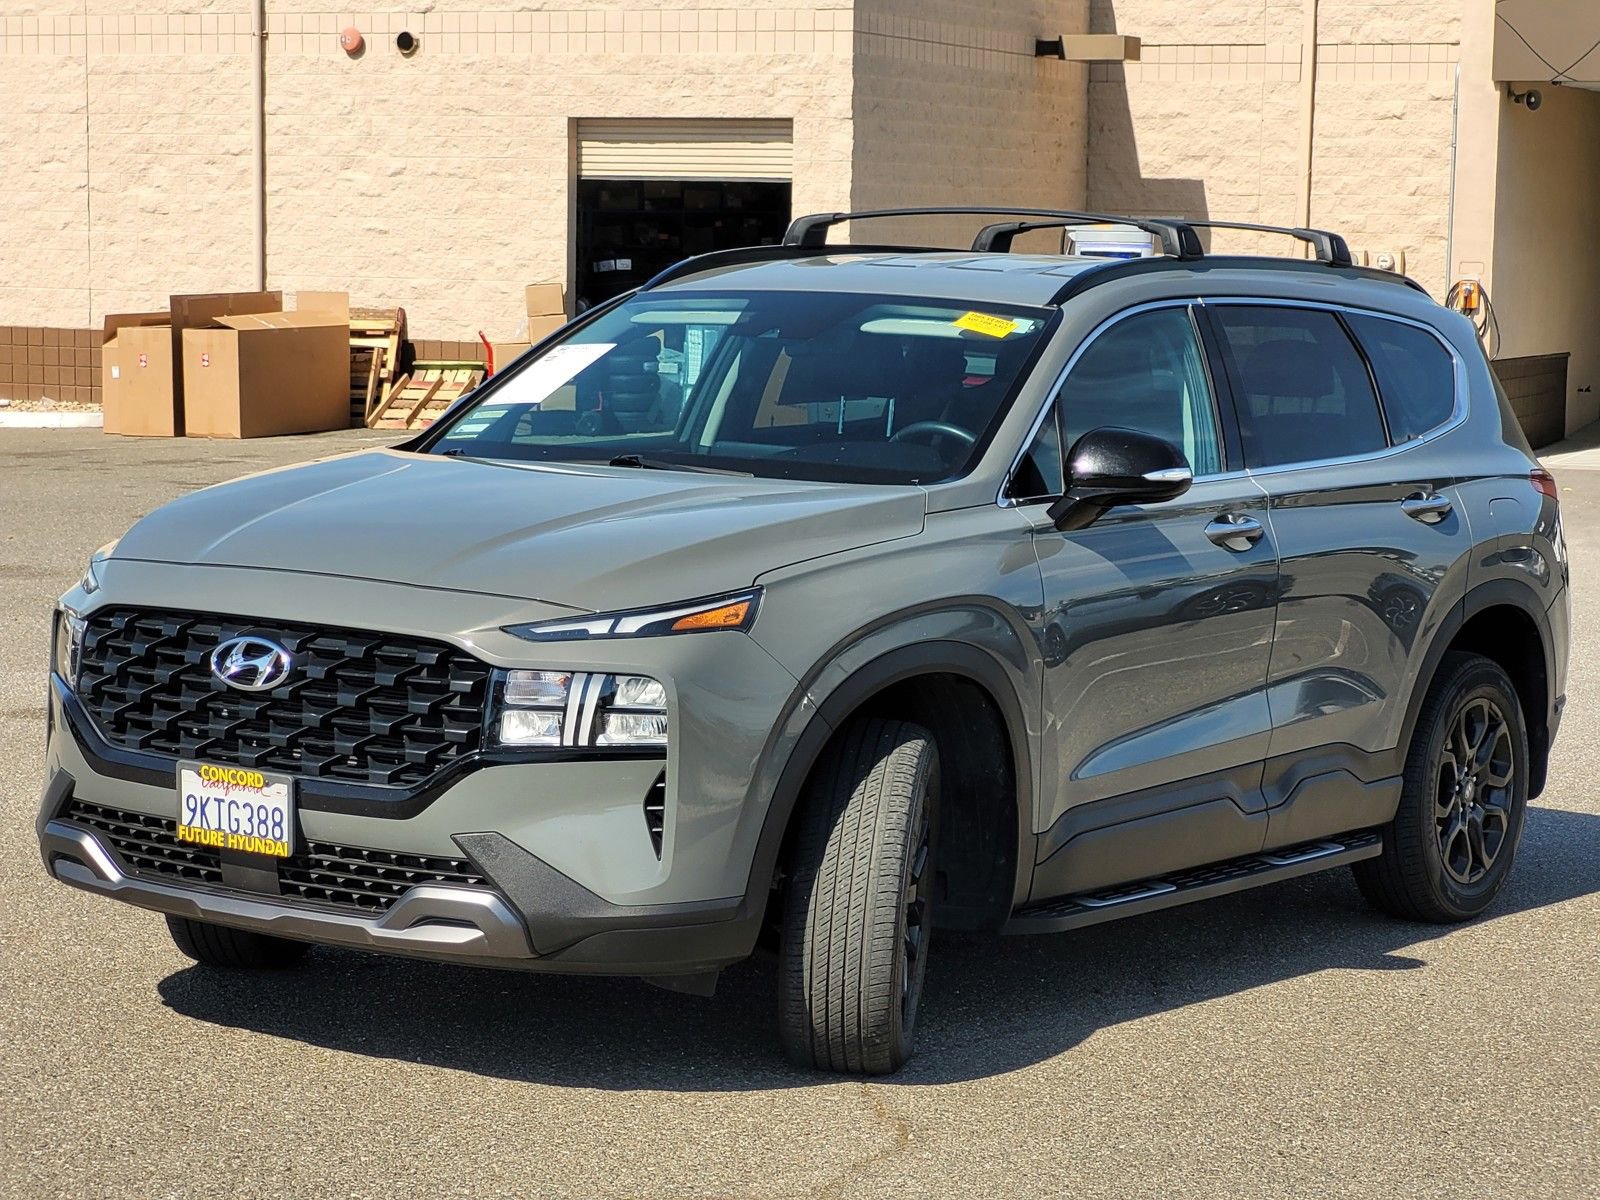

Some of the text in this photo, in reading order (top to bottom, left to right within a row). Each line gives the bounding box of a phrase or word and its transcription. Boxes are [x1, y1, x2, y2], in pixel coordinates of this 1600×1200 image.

[200, 764, 265, 789] CONCORD
[178, 824, 289, 858] FUTURE HYUNDAI
